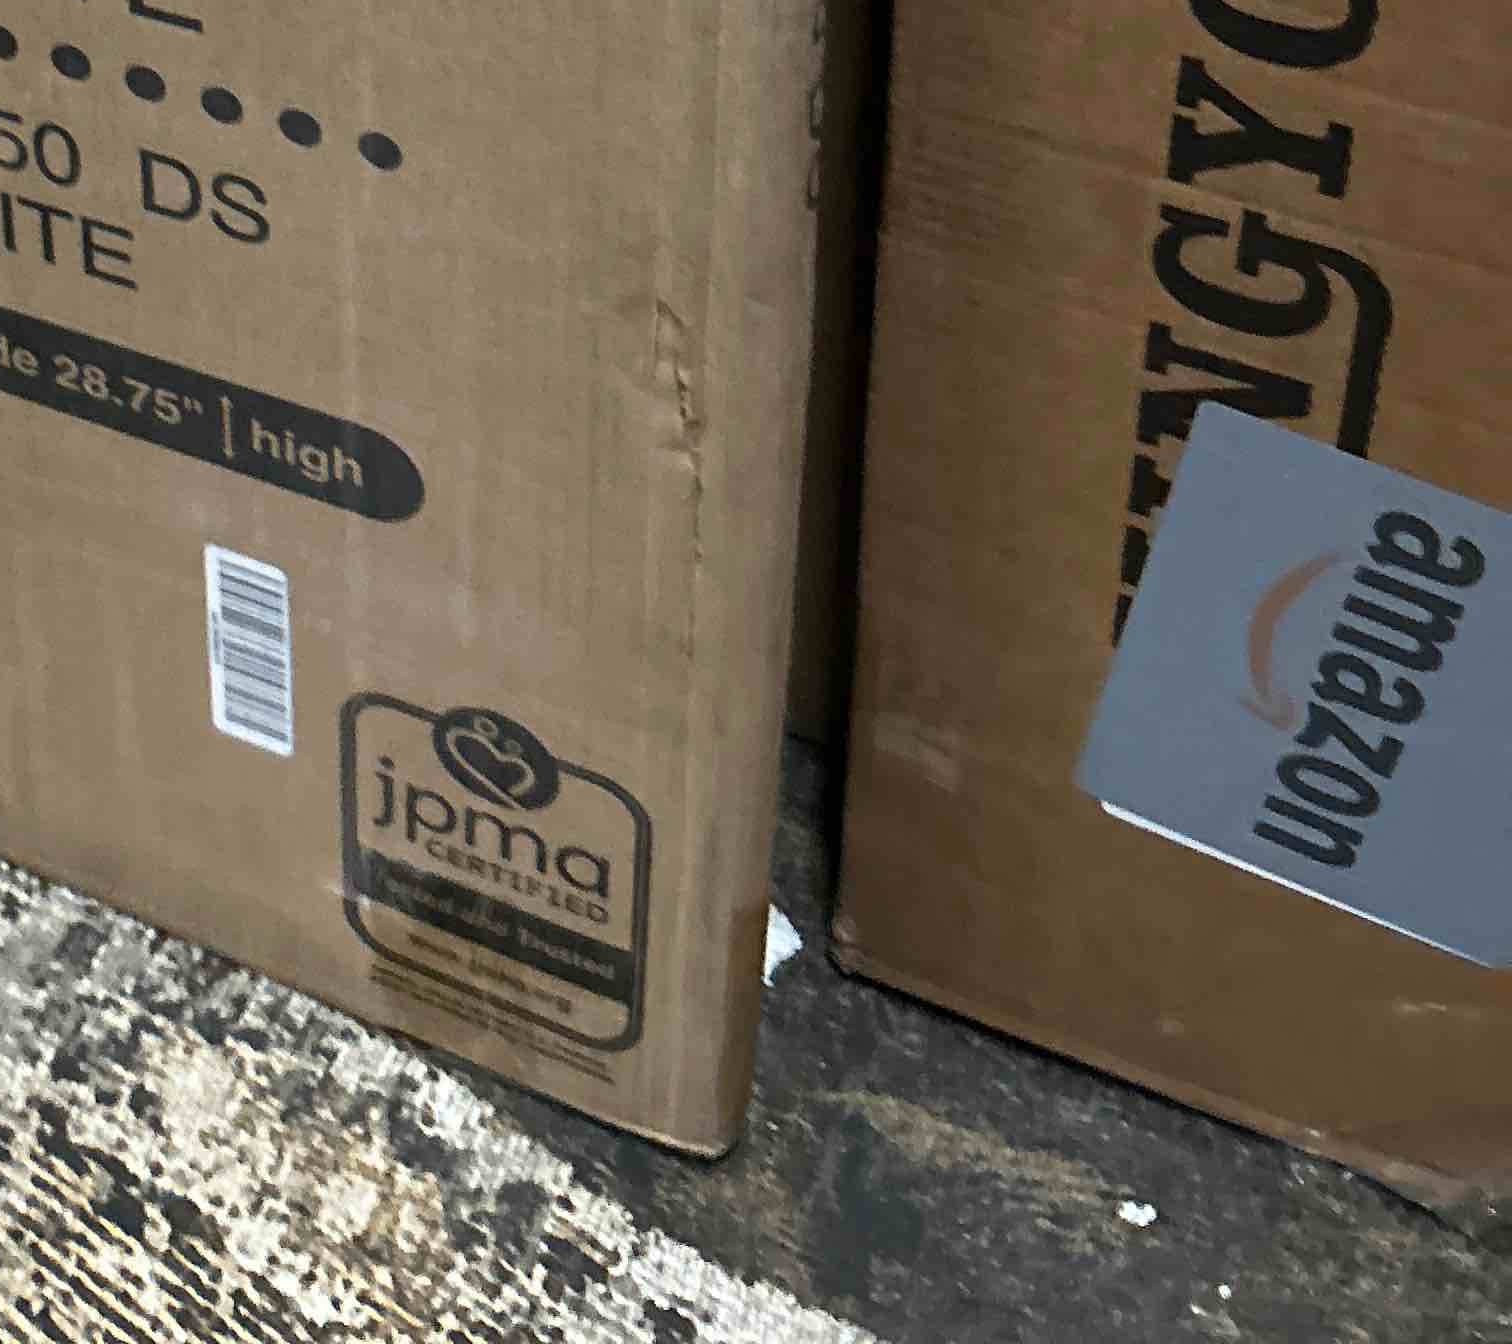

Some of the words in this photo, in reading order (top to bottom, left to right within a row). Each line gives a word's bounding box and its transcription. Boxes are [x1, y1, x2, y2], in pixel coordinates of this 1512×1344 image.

[140, 148, 269, 243] DS
[249, 418, 364, 488] high
[1253, 511, 1486, 868] amazon
[373, 757, 610, 899] jpma
